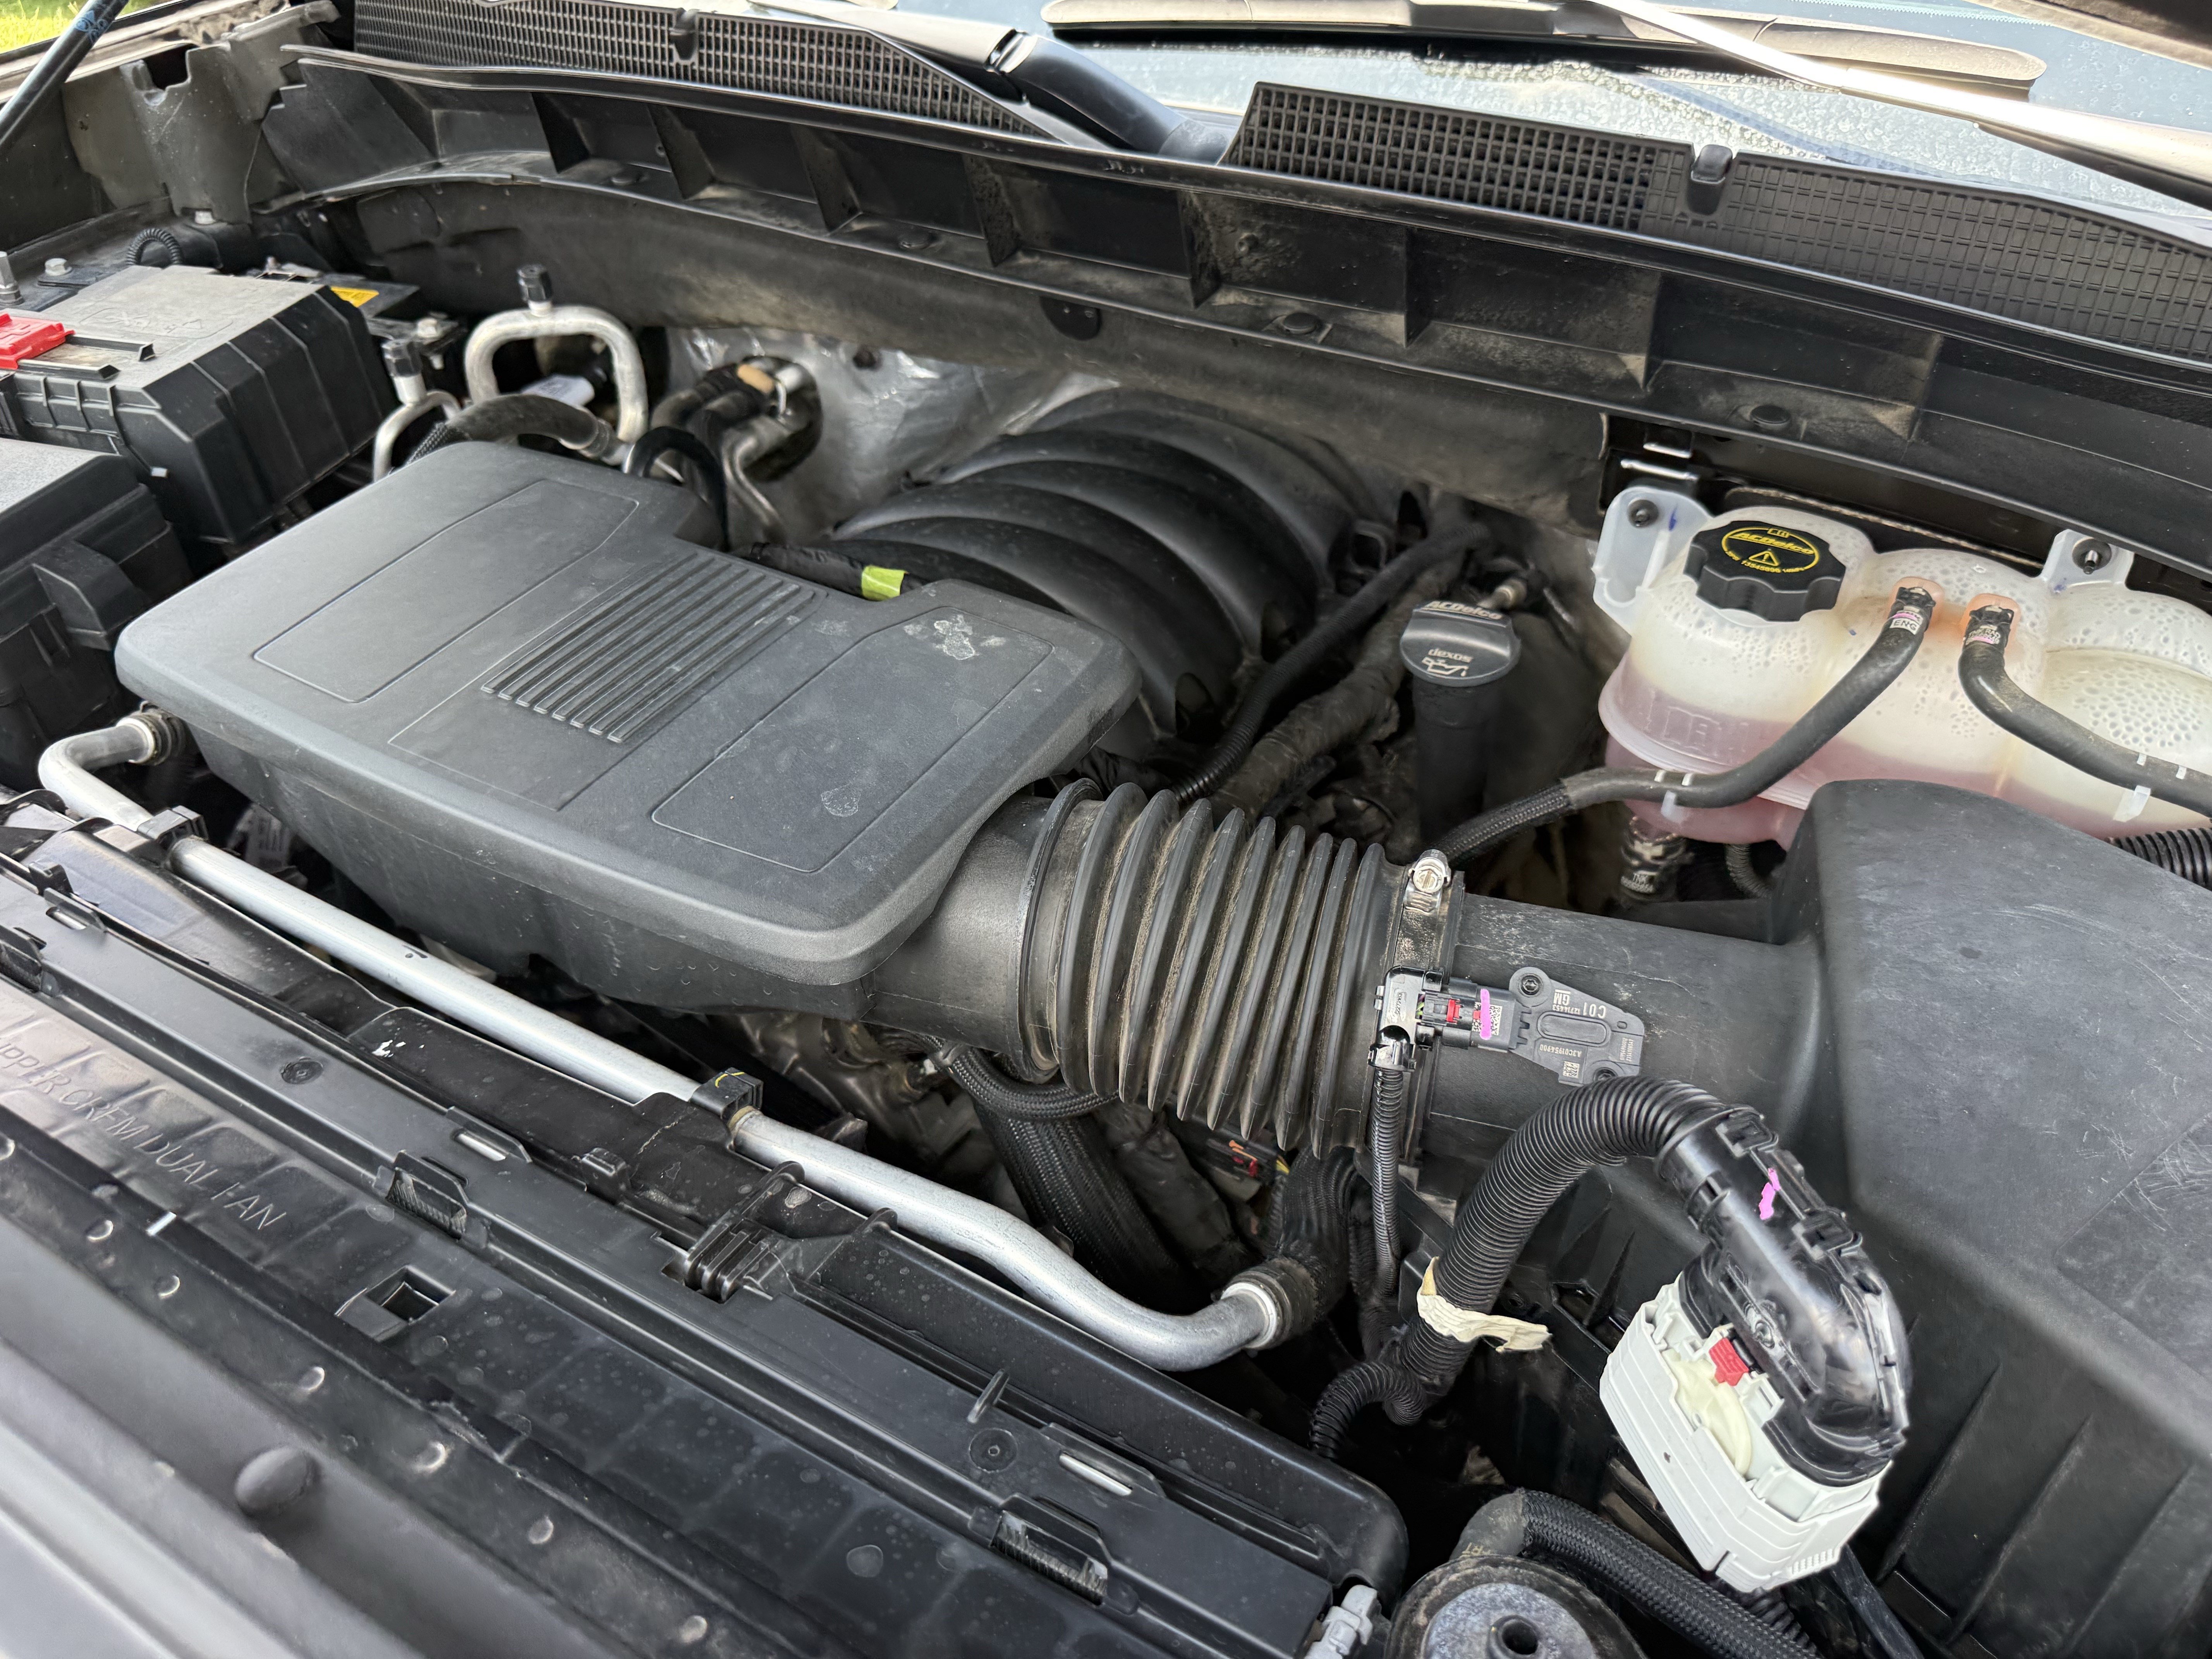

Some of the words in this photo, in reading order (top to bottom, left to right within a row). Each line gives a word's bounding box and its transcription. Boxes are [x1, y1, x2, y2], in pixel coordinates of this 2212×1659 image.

[1731, 532, 1815, 555] ACDelco
[1420, 600, 1503, 620] ACDelco
[1893, 620, 1917, 631] ENG
[1428, 648, 1473, 663] dexos
[1553, 990, 1570, 1006] GM
[1582, 1001, 1606, 1019] C01
[134, 1133, 218, 1192] DUAL
[210, 1182, 287, 1230] FAN
